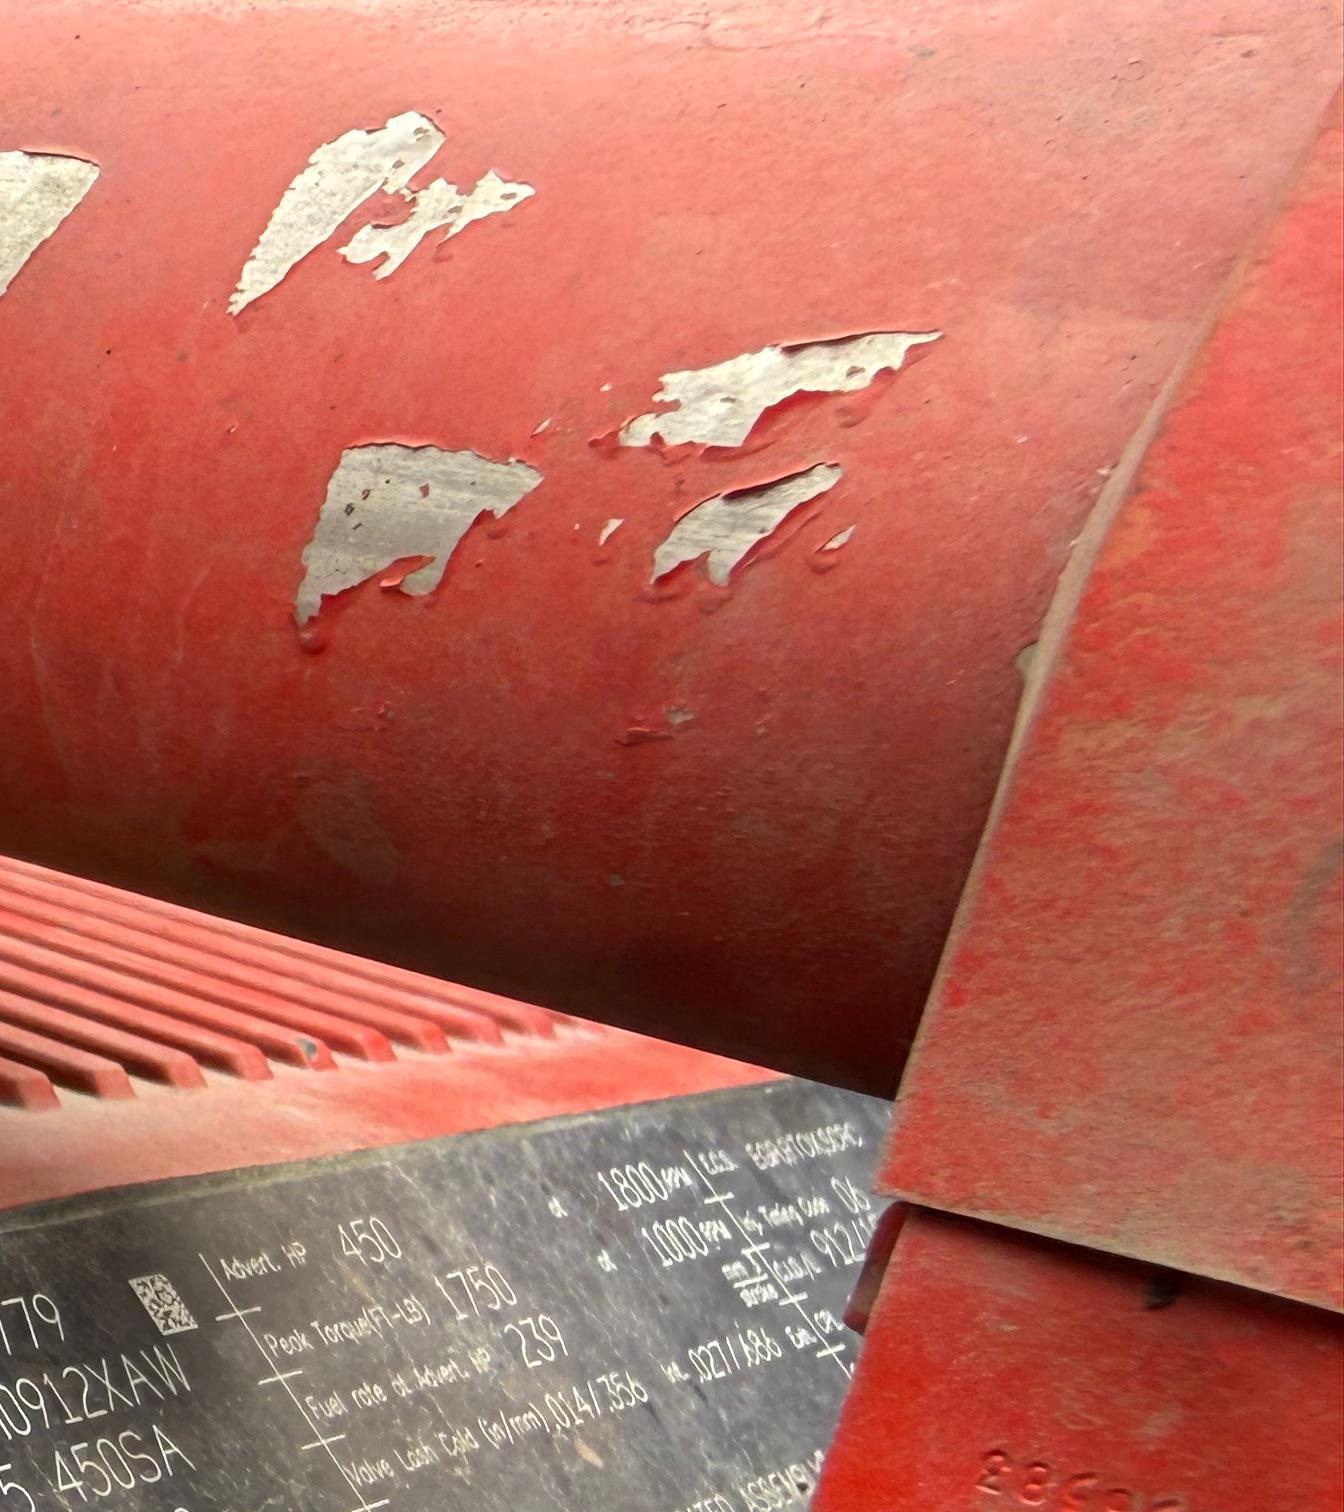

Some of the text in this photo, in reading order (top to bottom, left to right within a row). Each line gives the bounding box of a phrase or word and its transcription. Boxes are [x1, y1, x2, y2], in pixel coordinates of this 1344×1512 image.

[221, 1252, 282, 1281] Advert.
[281, 1241, 308, 1269] HP
[337, 1216, 402, 1266] 450
[598, 1161, 669, 1211] 1800
[263, 1329, 314, 1359] Peak
[434, 1261, 518, 1322] 1750
[642, 1215, 709, 1267] 1000
[303, 1390, 349, 1420] Fuel
[351, 1382, 388, 1409] rate
[391, 1375, 412, 1398] at
[467, 1344, 491, 1374] HP
[504, 1314, 569, 1369] 239
[54, 1424, 197, 1502] 450SA
[341, 1457, 395, 1488] Valve
[545, 1369, 649, 1432] .014/.356
